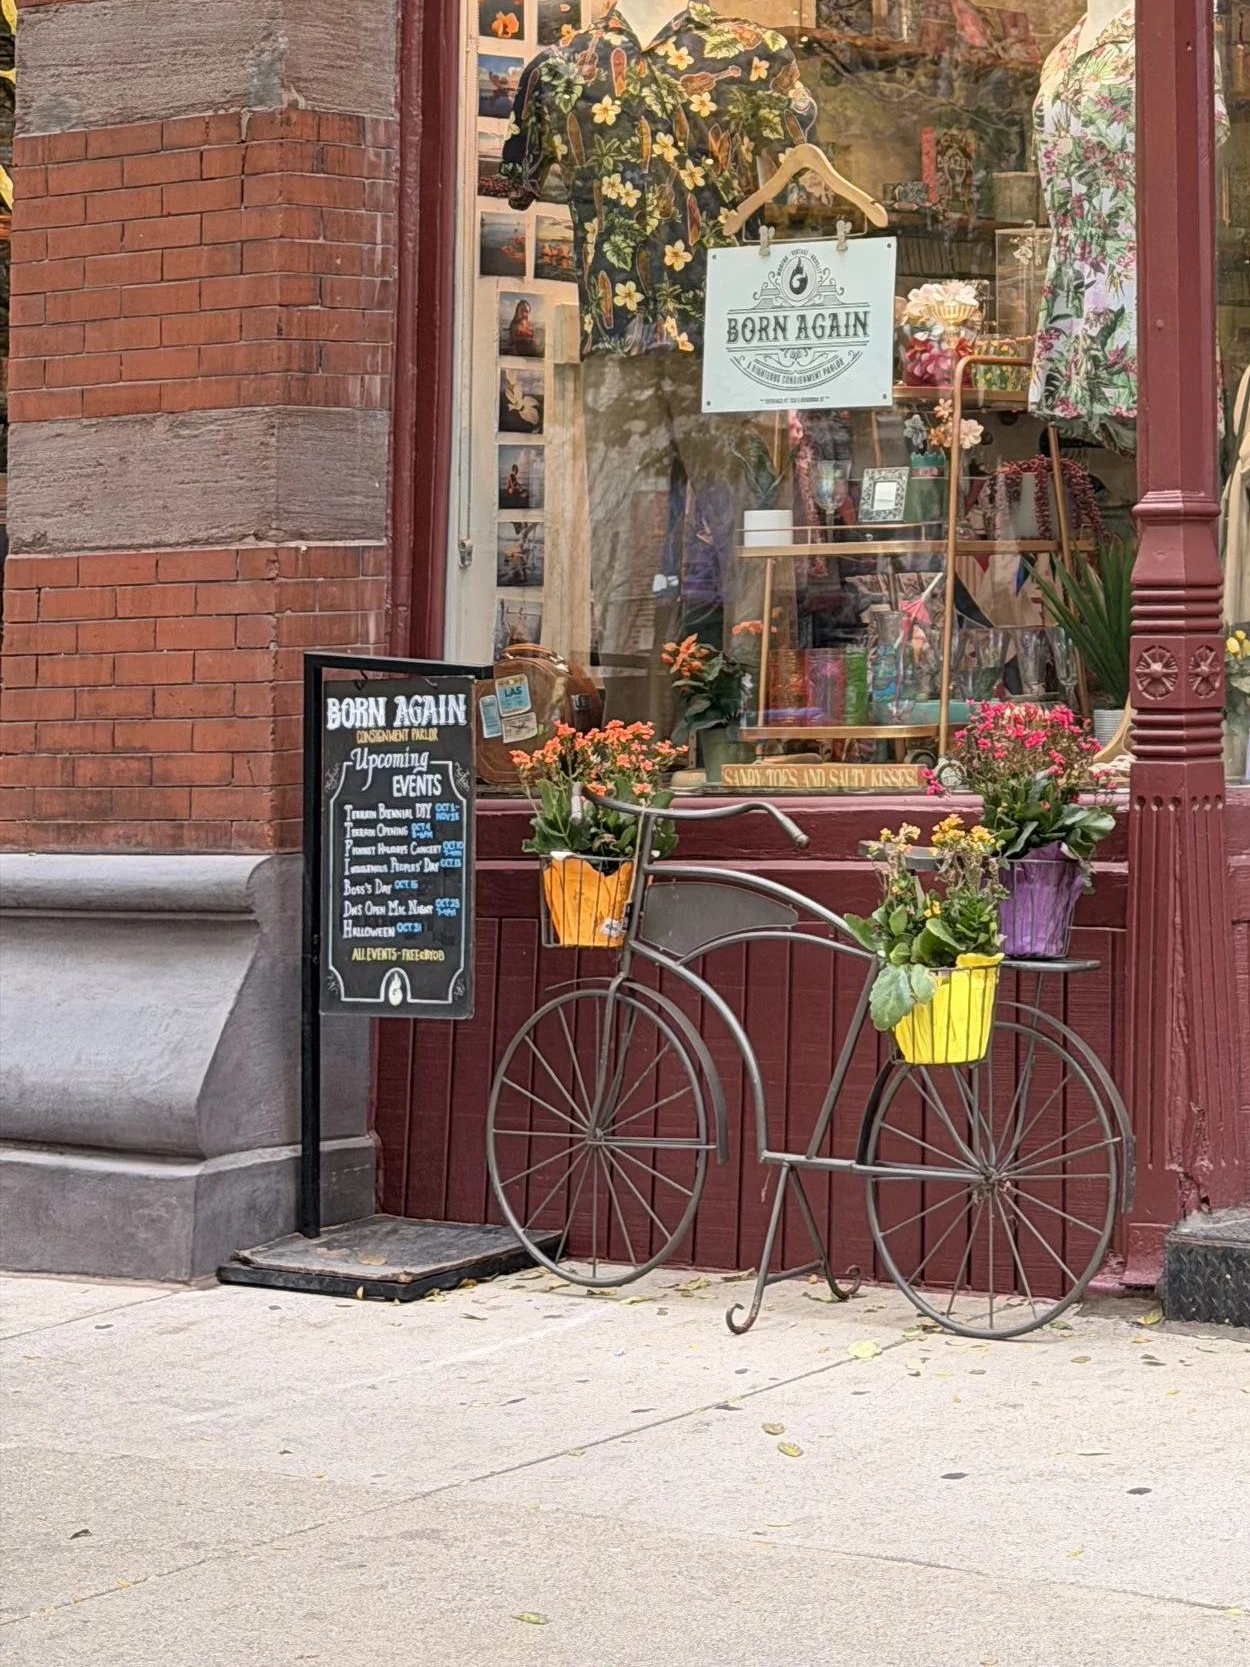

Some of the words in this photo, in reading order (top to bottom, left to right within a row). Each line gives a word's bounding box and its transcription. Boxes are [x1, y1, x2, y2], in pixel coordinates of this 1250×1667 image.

[727, 315, 789, 344] BORN
[796, 311, 870, 341] AGAIN
[504, 686, 522, 697] LAS
[327, 697, 388, 730] BORN
[393, 694, 467, 727] AGAIN
[350, 746, 429, 791] Upcoming
[803, 768, 826, 786] AND
[829, 768, 868, 787] SALTY
[392, 774, 442, 797] EVENTS
[415, 802, 432, 819] DIY
[423, 857, 439, 873] DAY
[374, 878, 392, 895] DAY
[365, 901, 386, 916] OPEN
[388, 900, 406, 916] MIC
[343, 919, 395, 939] HALLOWEEN
